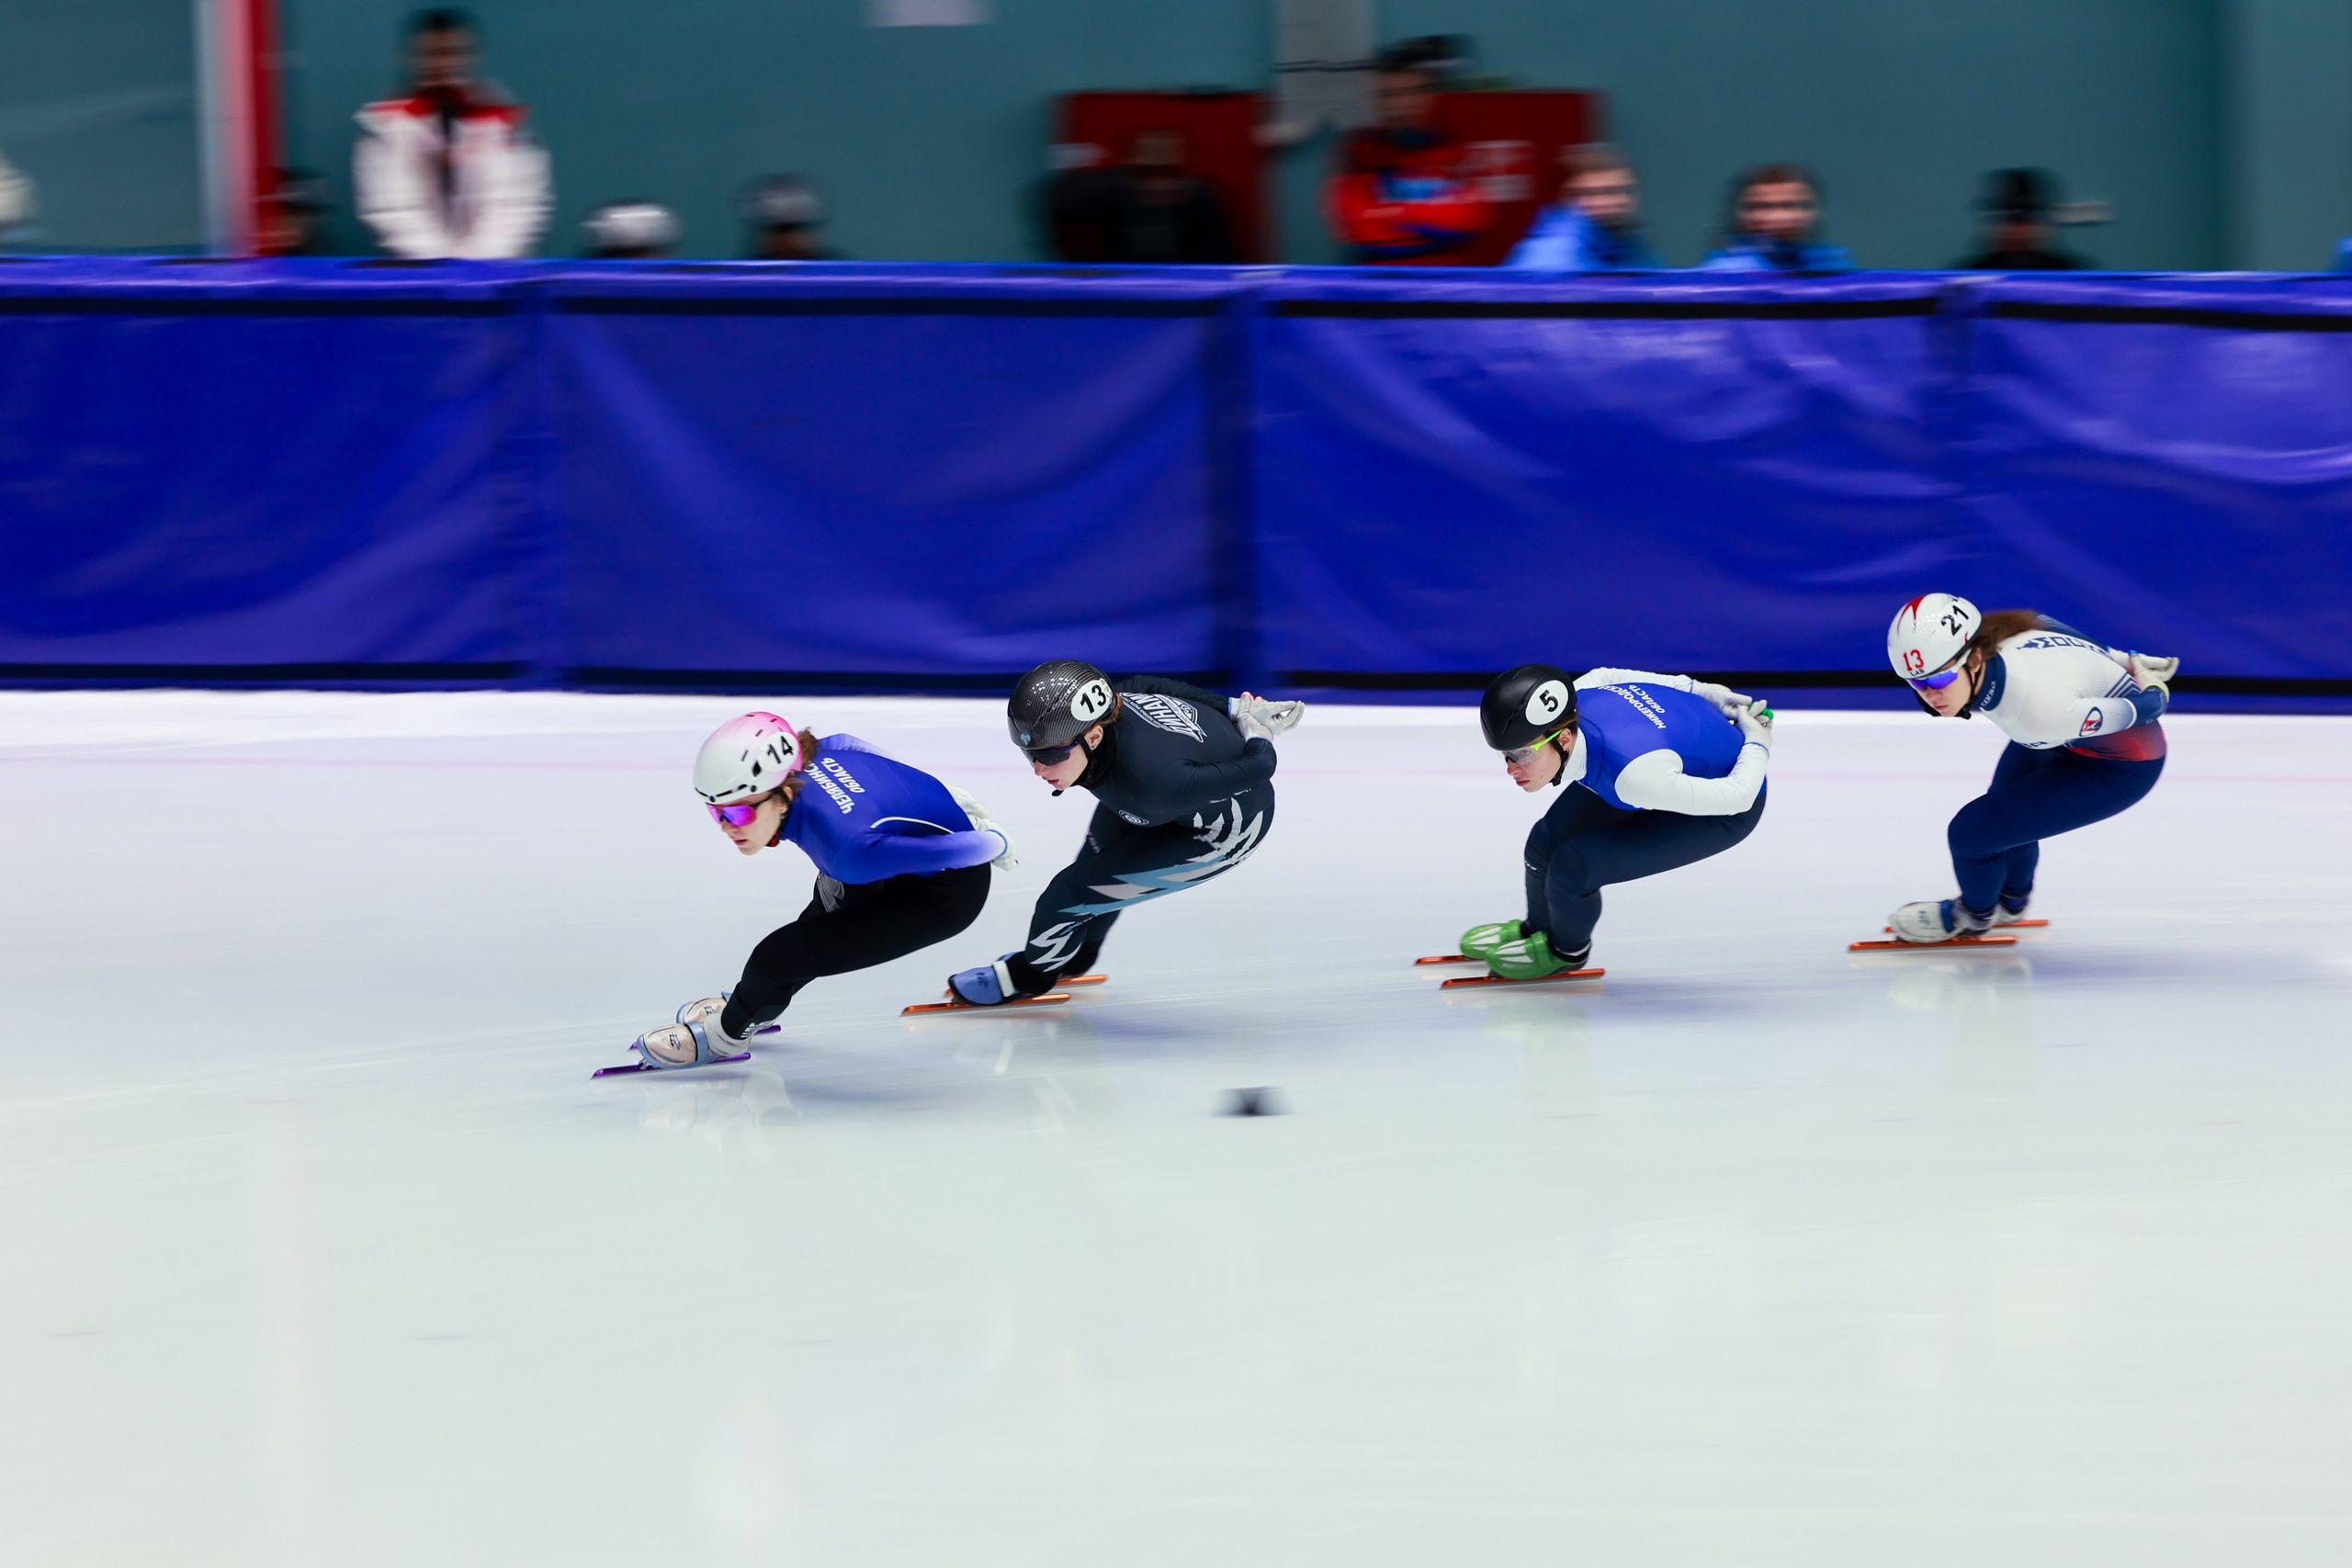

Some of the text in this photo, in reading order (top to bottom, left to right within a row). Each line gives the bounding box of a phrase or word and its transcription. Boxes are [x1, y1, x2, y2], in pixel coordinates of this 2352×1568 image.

[1940, 605, 1968, 635] 21
[1903, 649, 1924, 671] 13
[1080, 684, 1106, 713] 13
[1539, 689, 1558, 712] 5
[1629, 684, 1665, 714] ОБЛАСТЬ
[768, 736, 793, 763] 14
[804, 761, 854, 814] ЧЕЛЯБИНС
[821, 757, 865, 793] ОБЛАСТЬ
